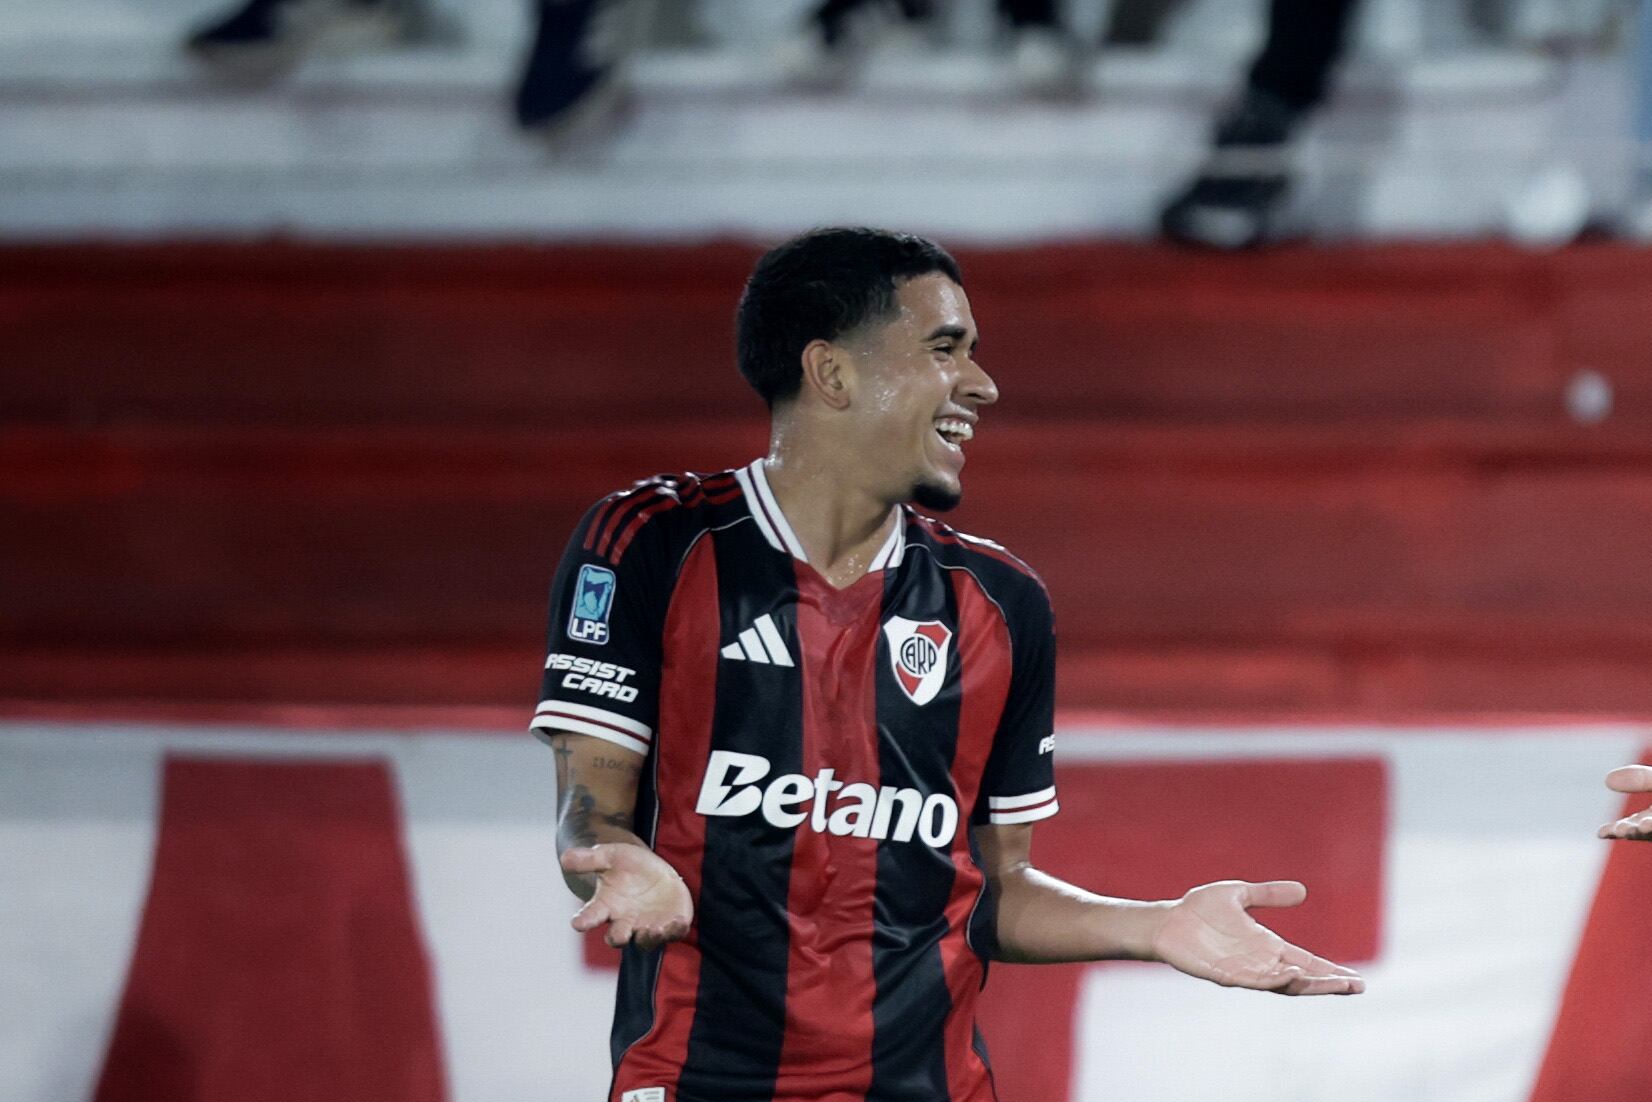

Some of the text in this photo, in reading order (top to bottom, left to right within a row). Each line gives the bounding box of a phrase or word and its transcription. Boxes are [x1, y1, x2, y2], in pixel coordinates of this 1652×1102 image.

[571, 618, 607, 641] LPF
[545, 653, 637, 683] ASSIST
[900, 636, 937, 675] CARP
[562, 672, 639, 703] CARD
[695, 750, 959, 848] Betano
